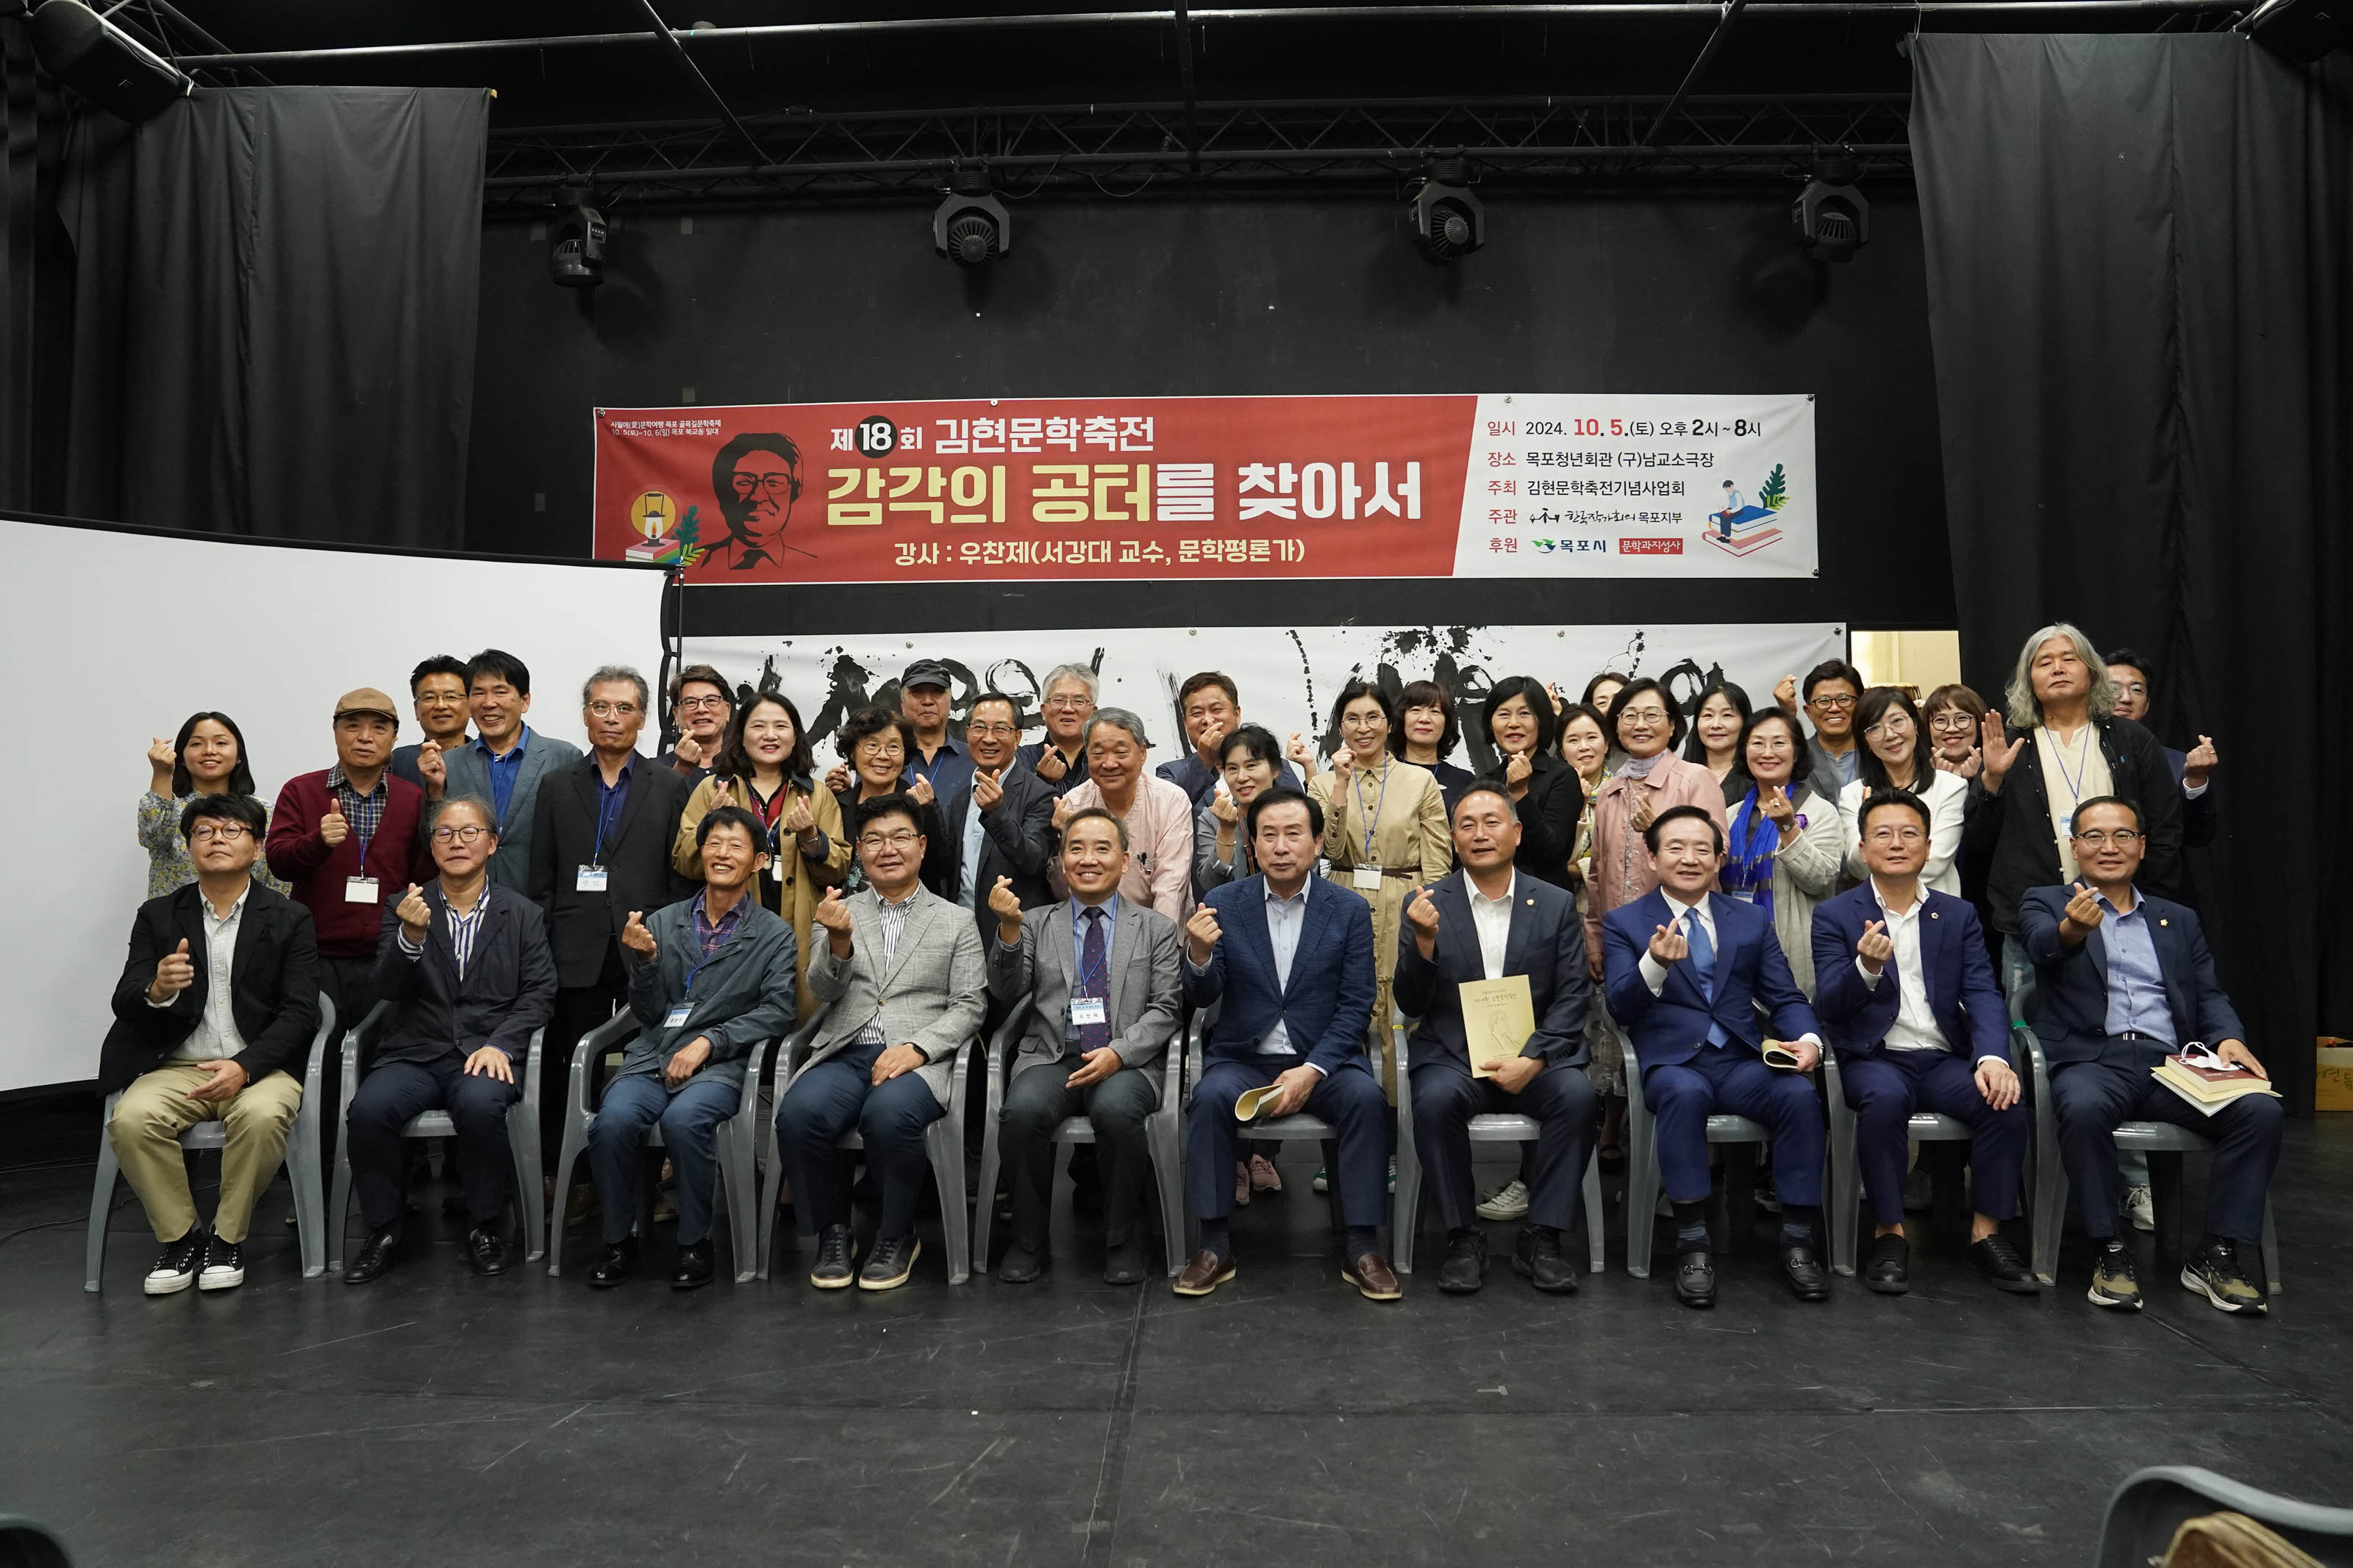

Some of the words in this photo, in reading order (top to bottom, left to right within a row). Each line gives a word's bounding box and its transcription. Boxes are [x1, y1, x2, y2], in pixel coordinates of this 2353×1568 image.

[679, 420, 721, 428] 골목길문학축제
[1488, 421, 1515, 436] 일시
[1527, 422, 1566, 434] 2024.
[1575, 419, 1604, 436] 10.
[1611, 419, 1654, 437] 5.(토)
[1660, 422, 1688, 436] 오후
[936, 416, 1153, 454] 김현문학축전
[1488, 452, 1515, 467] 장소
[1527, 452, 1613, 467] 목포청년회관
[828, 465, 1005, 525] 감각의
[1032, 464, 1214, 522] 공터를
[1238, 462, 1421, 520] 찾아서
[1488, 481, 1515, 495] 주최
[1528, 481, 1684, 495] 김현문학축전기념사업회
[1488, 509, 1517, 523] 주관
[1565, 510, 1635, 525] 한국작가회의
[1639, 512, 1682, 523] 목포지부
[895, 543, 939, 565] 강사
[960, 541, 1111, 565] 우찬제(서강대
[1119, 541, 1171, 565] 교수,
[1179, 539, 1304, 562] 문학평론가)
[1489, 538, 1517, 553] 후원
[1560, 540, 1606, 552] 목포시
[1621, 540, 1681, 553] 문학과지성사
